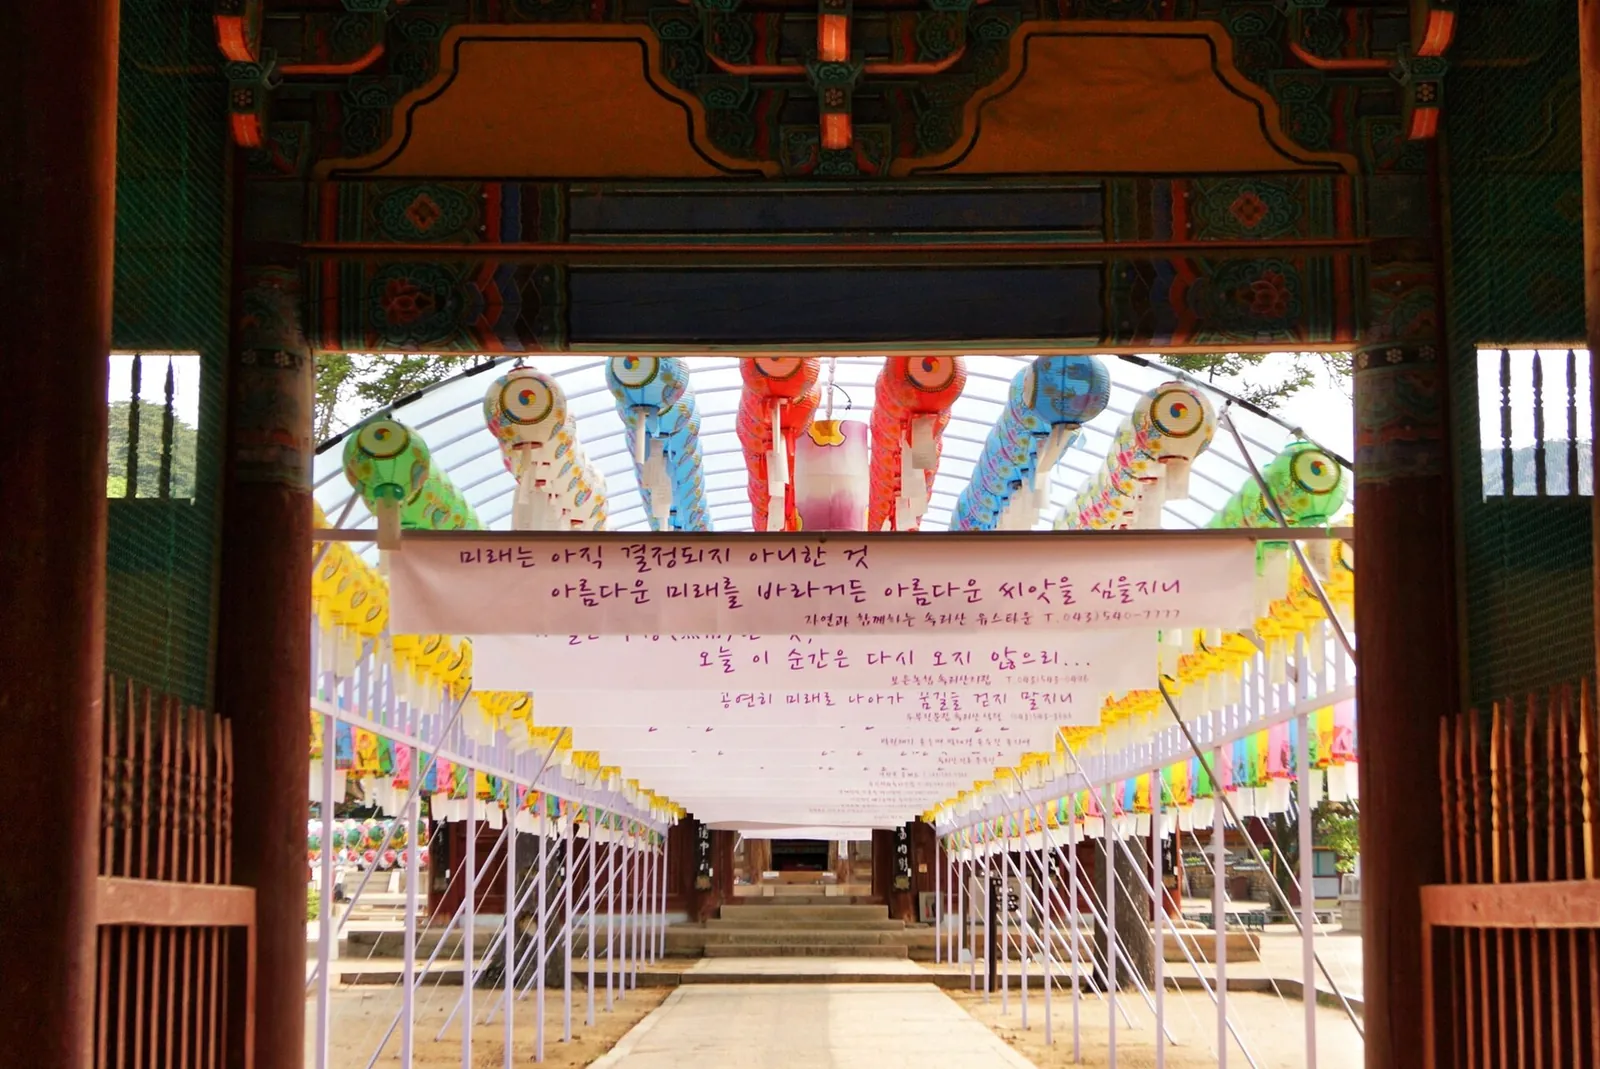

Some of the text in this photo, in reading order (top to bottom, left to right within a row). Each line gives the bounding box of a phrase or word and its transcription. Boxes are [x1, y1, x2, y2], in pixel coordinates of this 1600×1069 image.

[460, 543, 869, 573] 미래는 아직 결정되지 아니한 것
[551, 576, 1180, 609] 아름다운 미래를 바라거든 아름다운 씨앗을 심을지니
[804, 613, 850, 628] 자연과
[856, 612, 916, 628] 함께하는
[924, 612, 967, 627] 속리산
[975, 612, 1034, 627] 유스타운
[699, 645, 736, 674] 오늘
[752, 650, 769, 665] 이
[787, 648, 850, 671] 순간은
[866, 650, 914, 666] 다시
[932, 651, 971, 666] 오지
[720, 692, 773, 711] 공연히
[848, 692, 905, 706] 나아가
